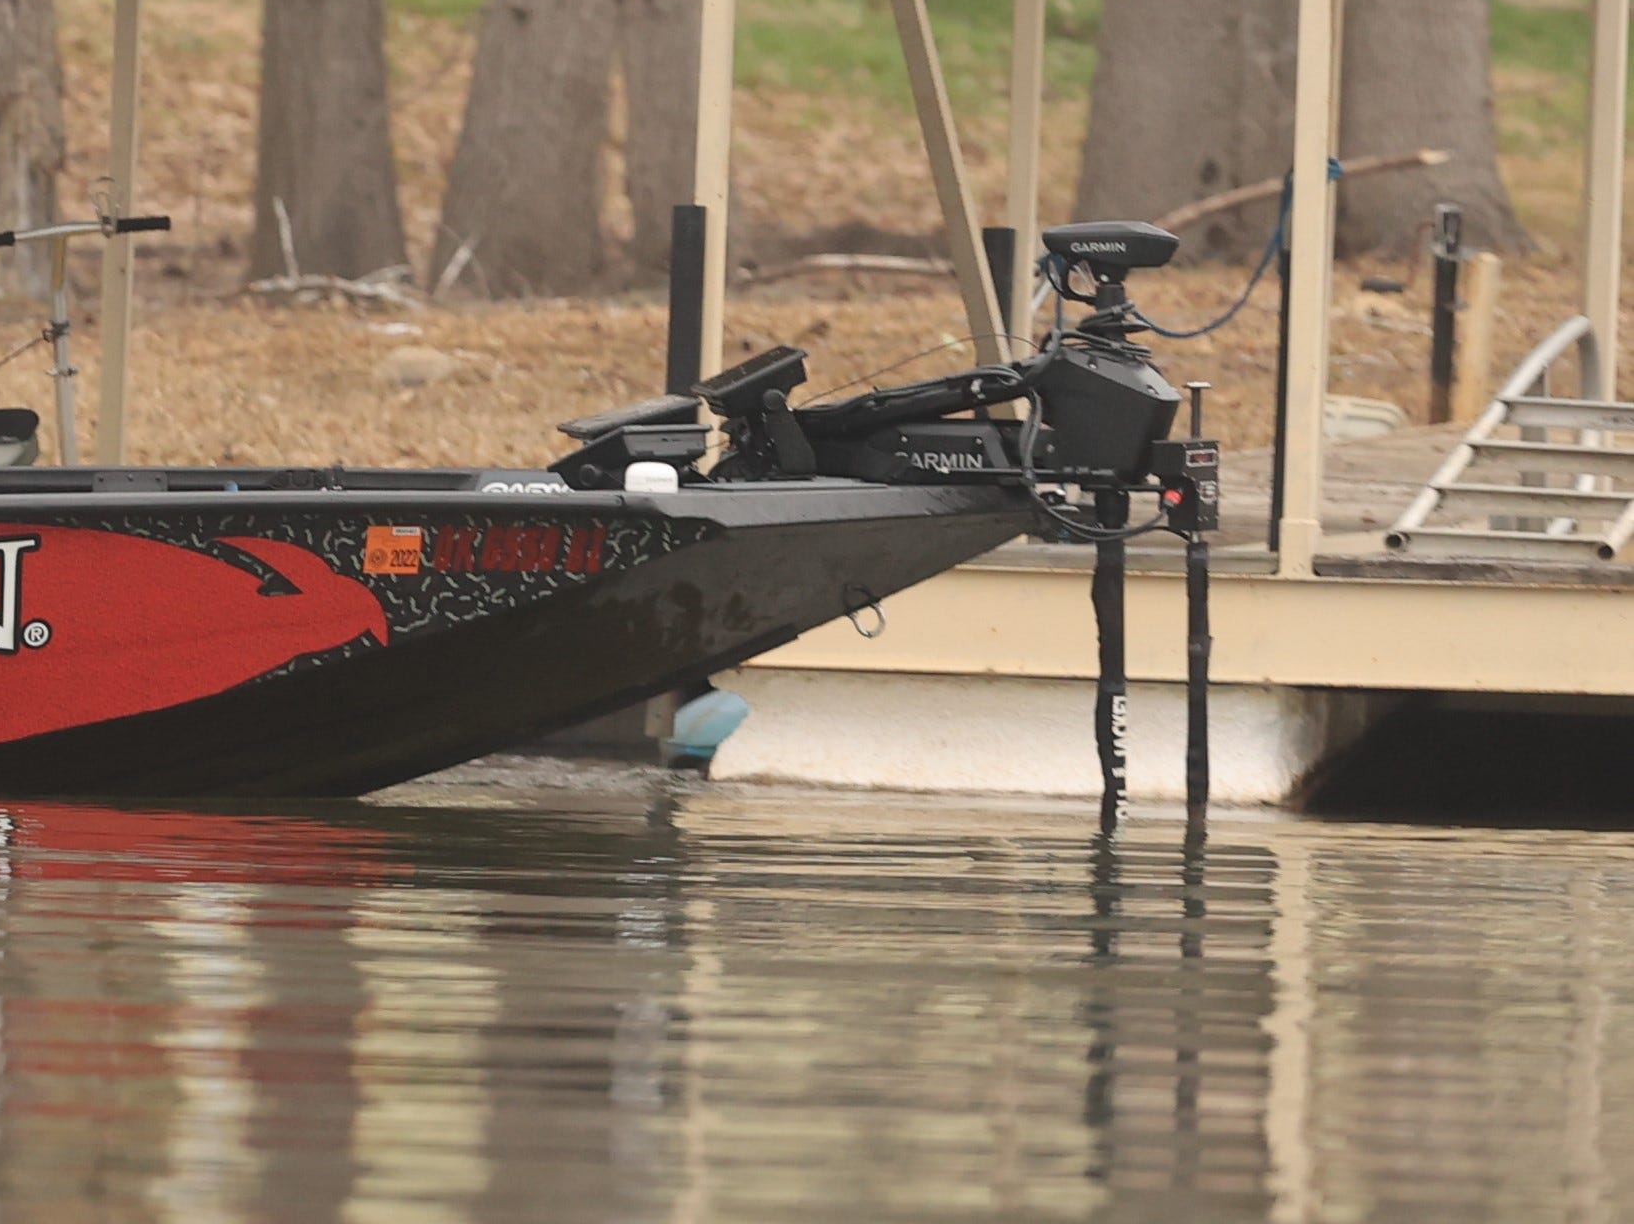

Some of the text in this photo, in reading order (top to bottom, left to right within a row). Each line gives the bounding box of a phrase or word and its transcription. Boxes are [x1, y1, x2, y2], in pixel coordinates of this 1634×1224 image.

[1071, 242, 1127, 254] GARMIN
[895, 452, 984, 471] ARMIN
[390, 550, 418, 568] 2022
